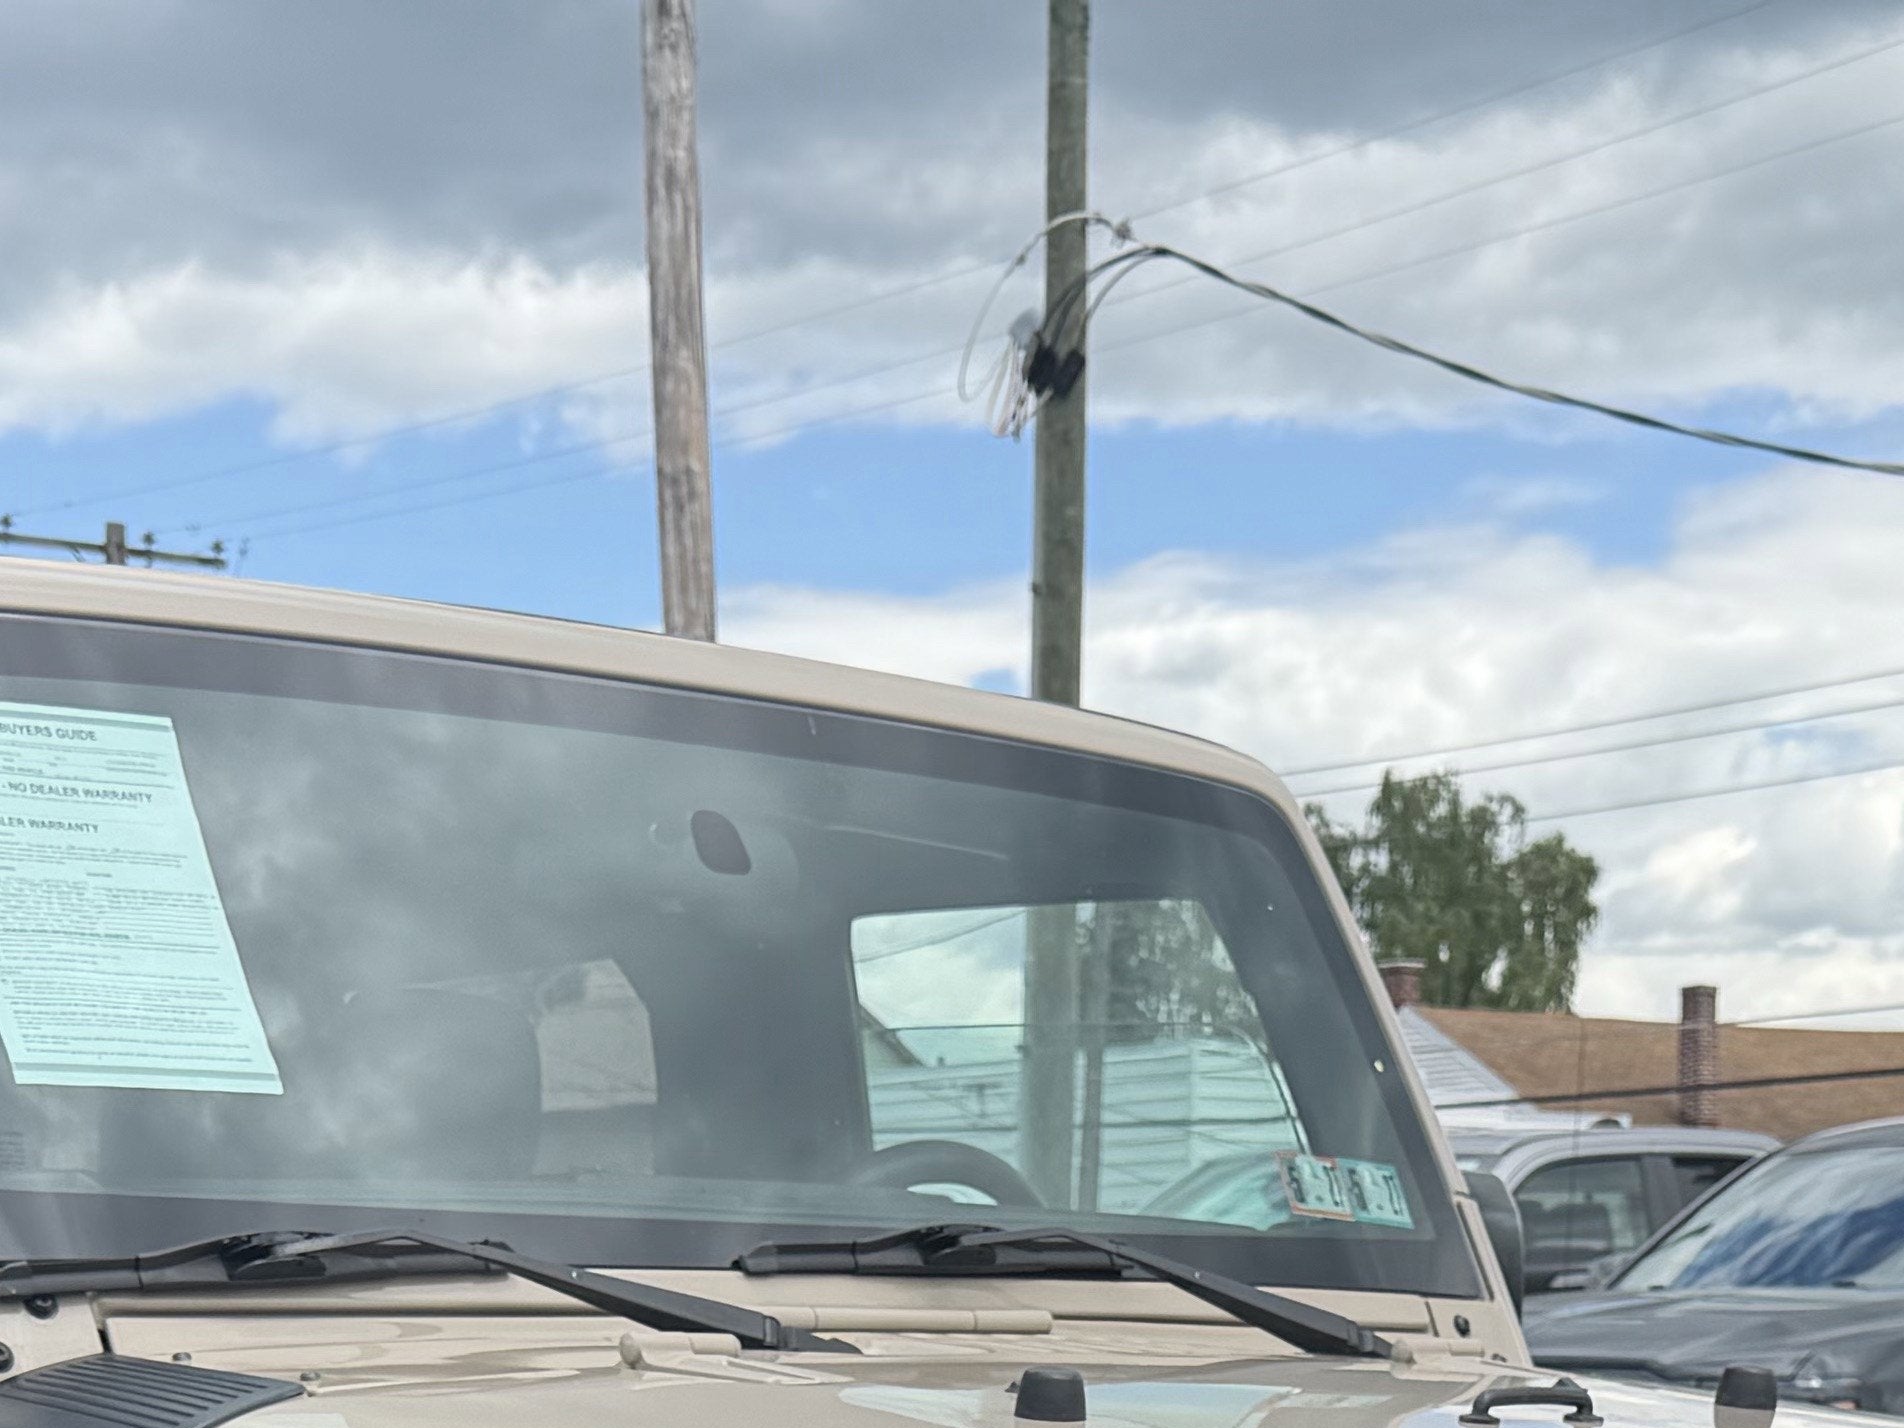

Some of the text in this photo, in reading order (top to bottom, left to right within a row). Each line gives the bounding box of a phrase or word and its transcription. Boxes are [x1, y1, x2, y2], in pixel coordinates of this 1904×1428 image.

[56, 727, 98, 742] GUIDE
[8, 781, 27, 793] NO
[30, 783, 80, 799] DEALER
[82, 788, 153, 803] WARRANTY
[28, 818, 100, 834] WARRANTY
